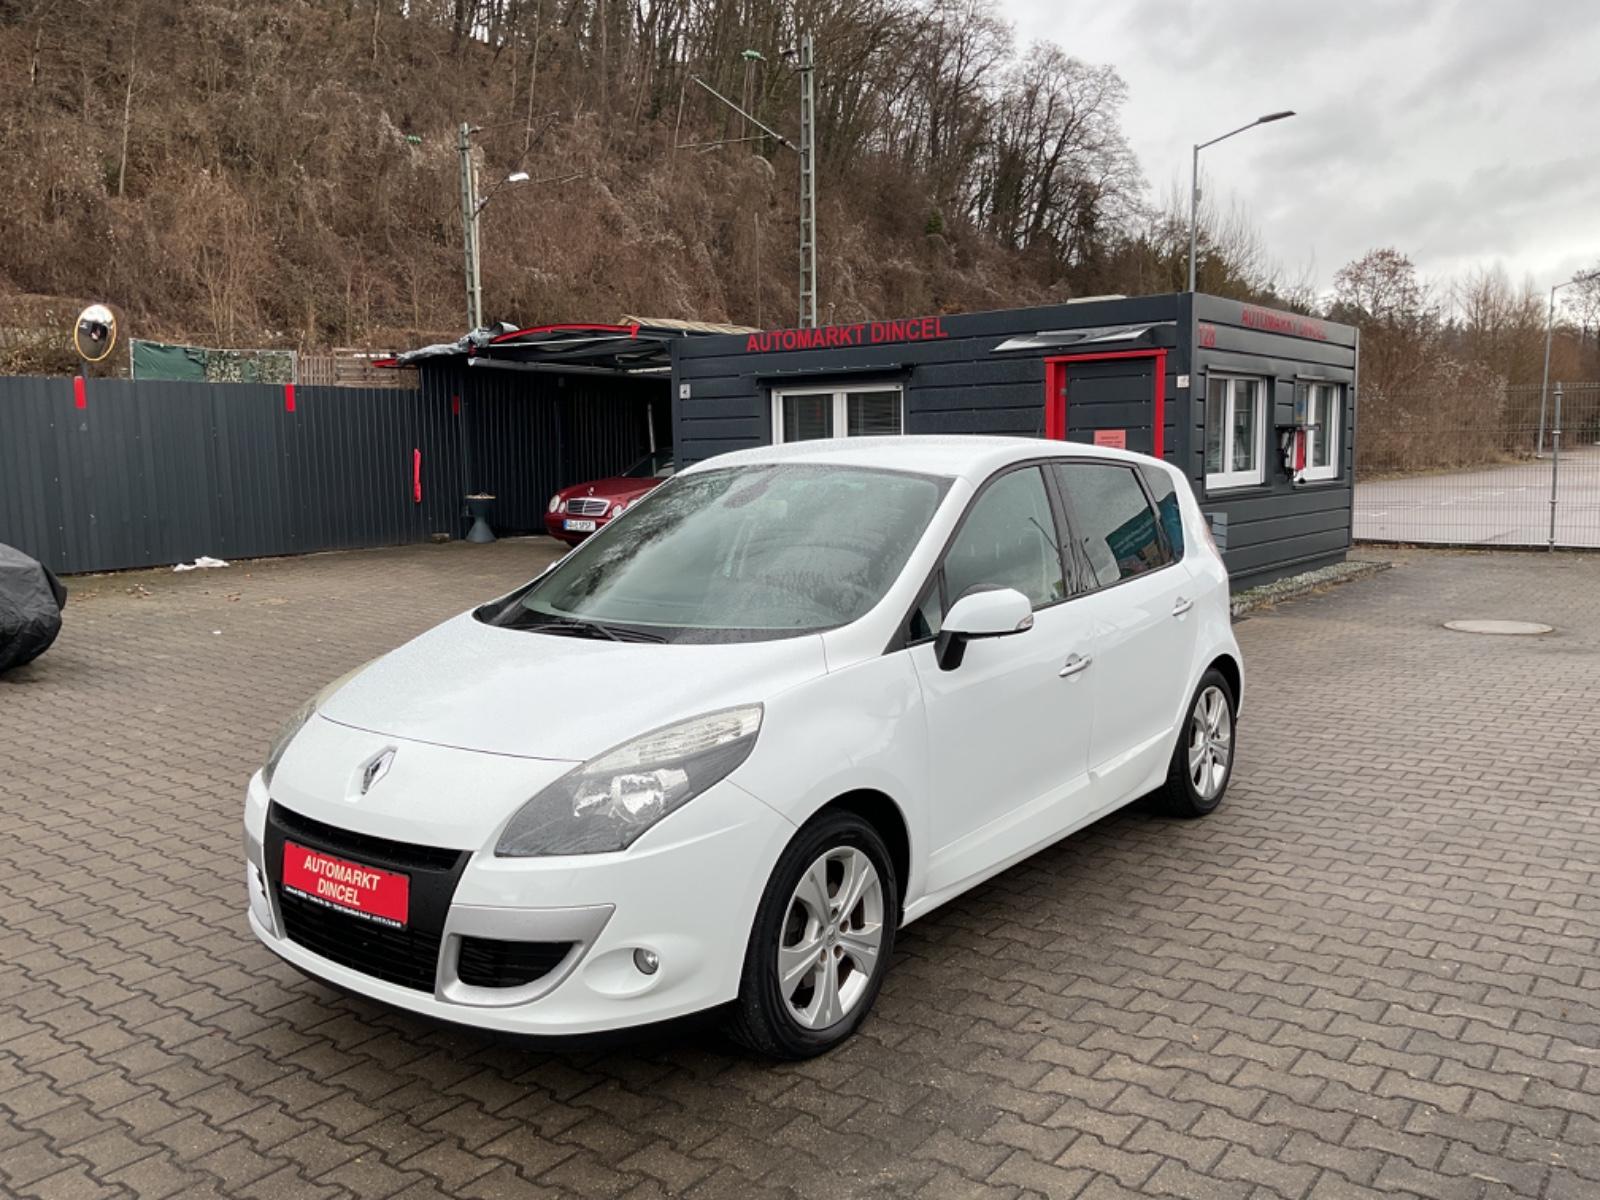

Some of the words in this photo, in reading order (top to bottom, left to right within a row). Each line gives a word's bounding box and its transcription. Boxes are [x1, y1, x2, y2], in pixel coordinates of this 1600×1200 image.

[746, 324, 865, 352] AUTOMARKT
[870, 317, 948, 343] DINCEL
[304, 855, 381, 891] AUTOMARKT
[317, 878, 361, 906] DINCEL
